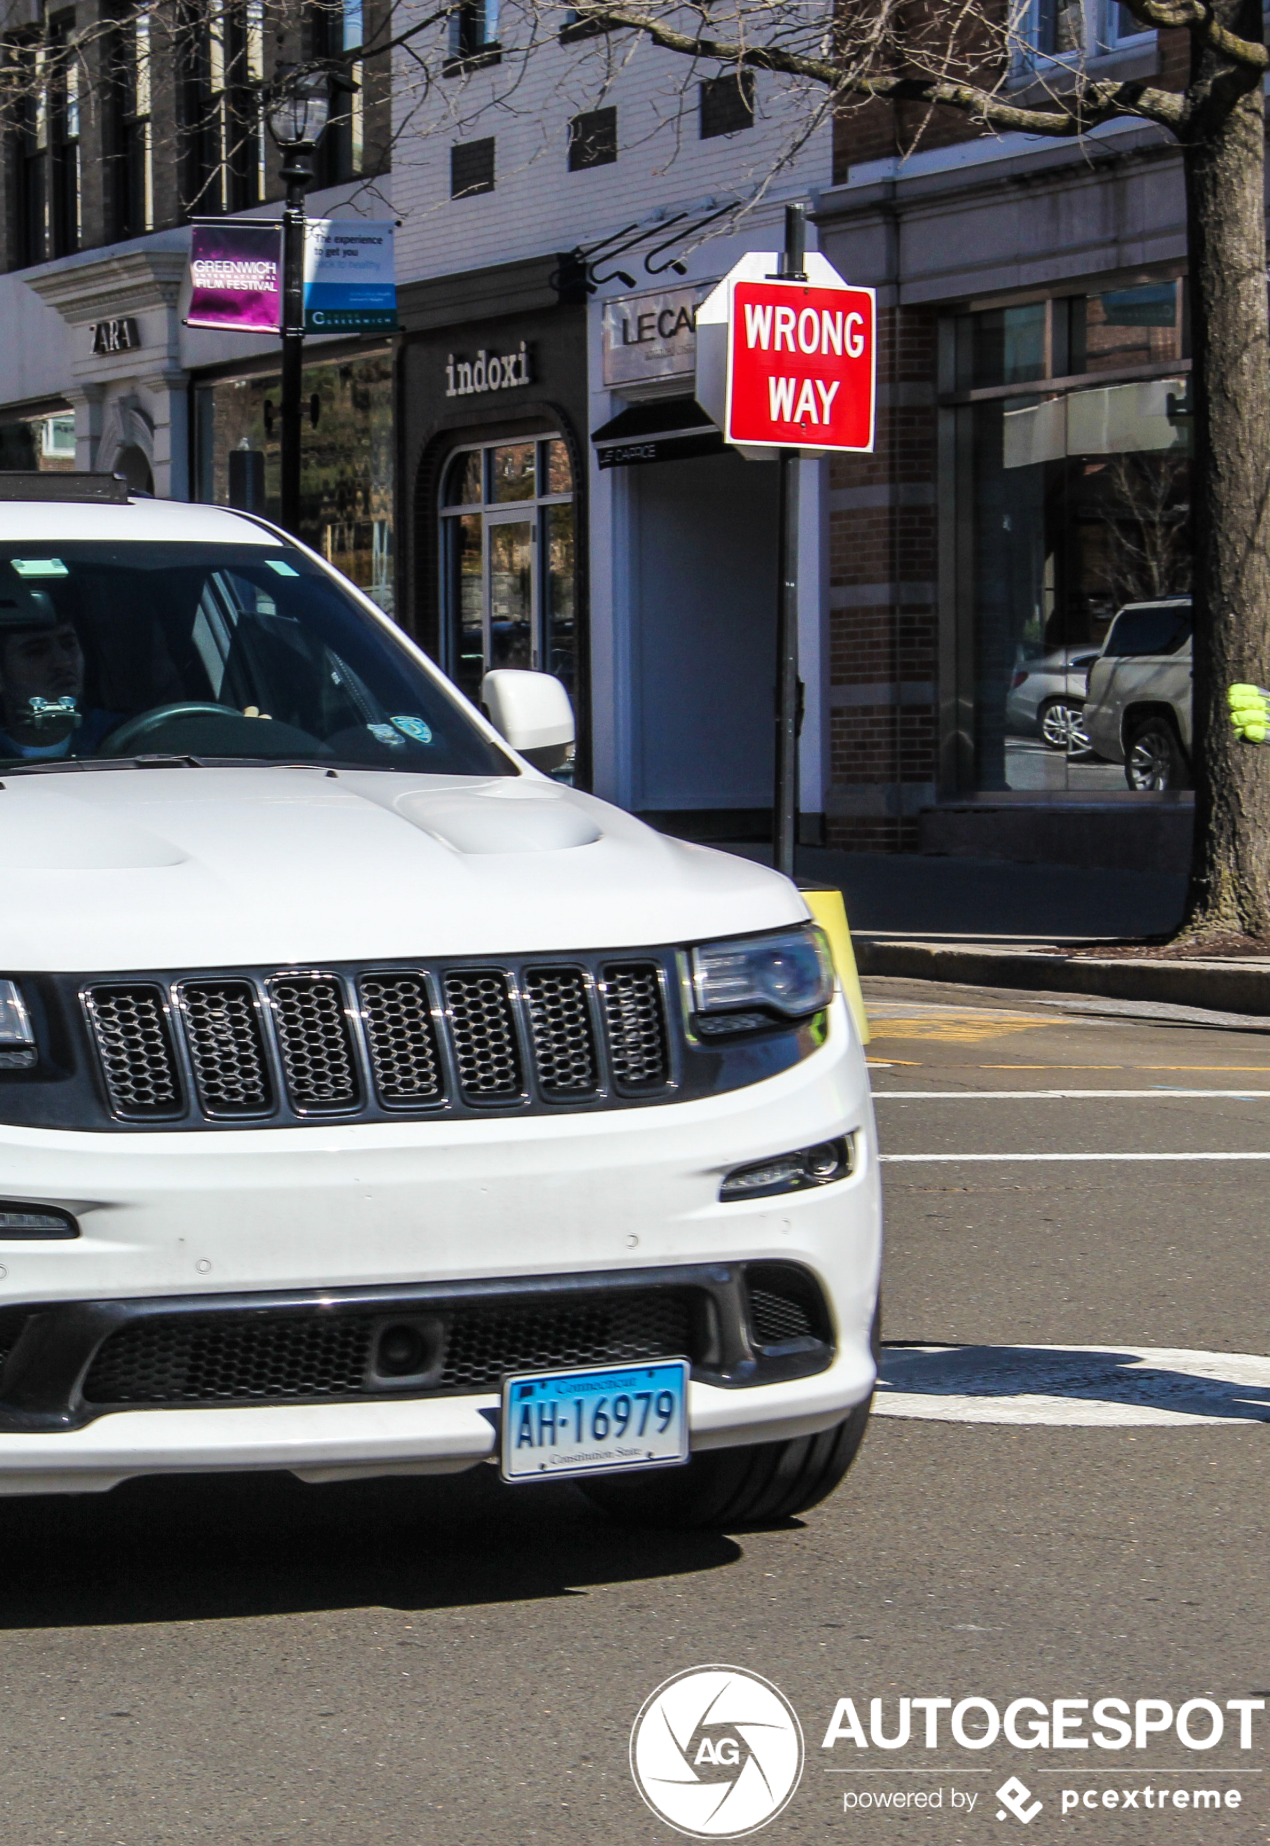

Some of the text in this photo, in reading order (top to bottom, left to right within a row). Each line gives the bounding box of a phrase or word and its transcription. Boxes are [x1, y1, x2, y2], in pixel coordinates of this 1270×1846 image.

[334, 234, 383, 246] experience
[314, 247, 359, 258] to get you
[193, 260, 277, 275] GREENWICH
[195, 278, 279, 293] FILM FESTIVAL
[88, 317, 135, 355] ZARA
[743, 303, 866, 359] WRONG
[445, 340, 530, 397] indoxi
[768, 376, 841, 425] WAY
[554, 1376, 638, 1395] Connecticut
[549, 1449, 615, 1466] Constitution
